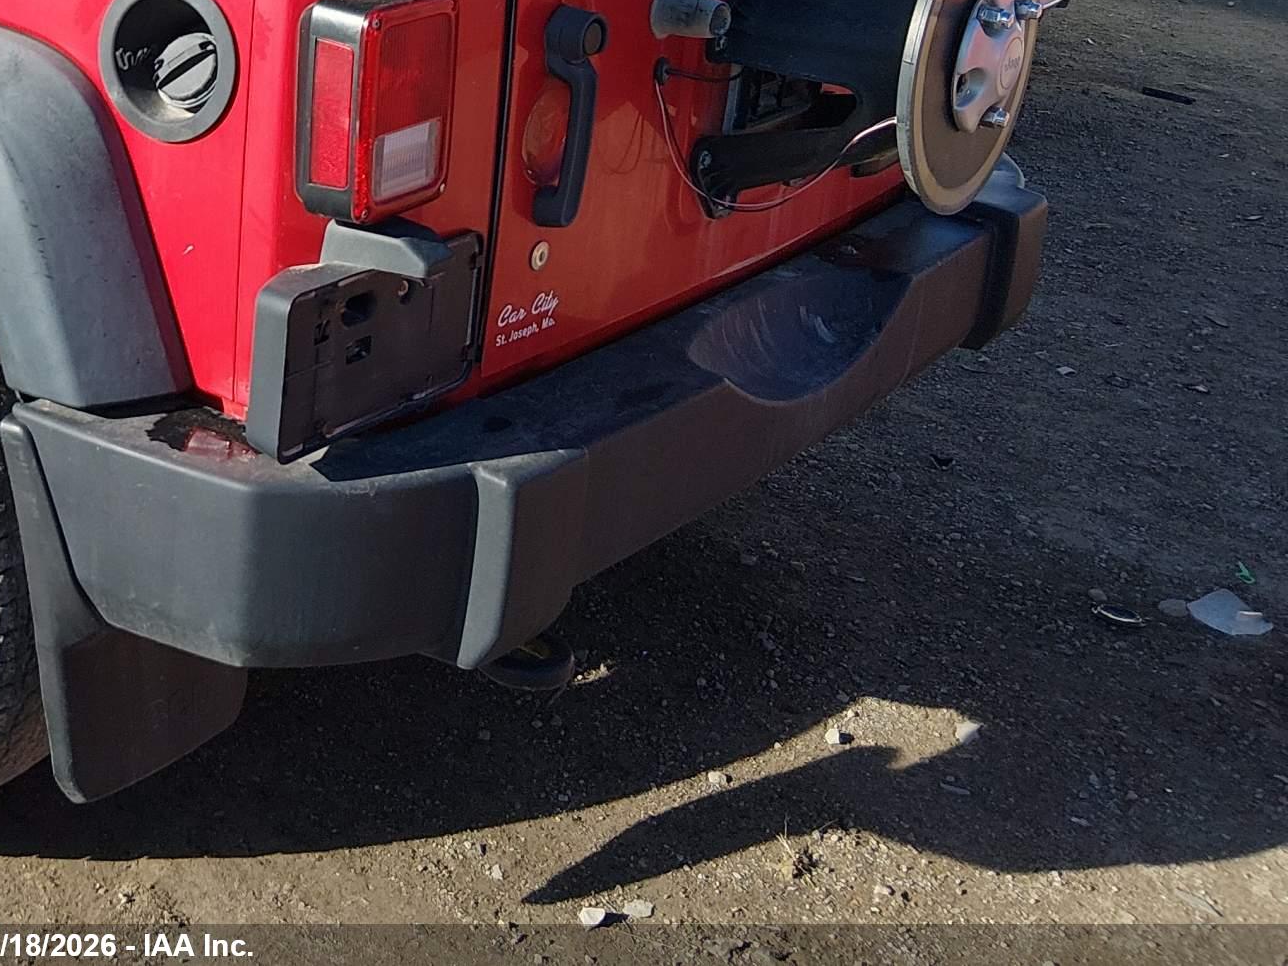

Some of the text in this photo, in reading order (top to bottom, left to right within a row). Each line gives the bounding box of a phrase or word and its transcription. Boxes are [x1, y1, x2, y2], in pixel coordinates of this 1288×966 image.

[497, 289, 559, 327] Car City
[495, 334, 508, 347] St.
